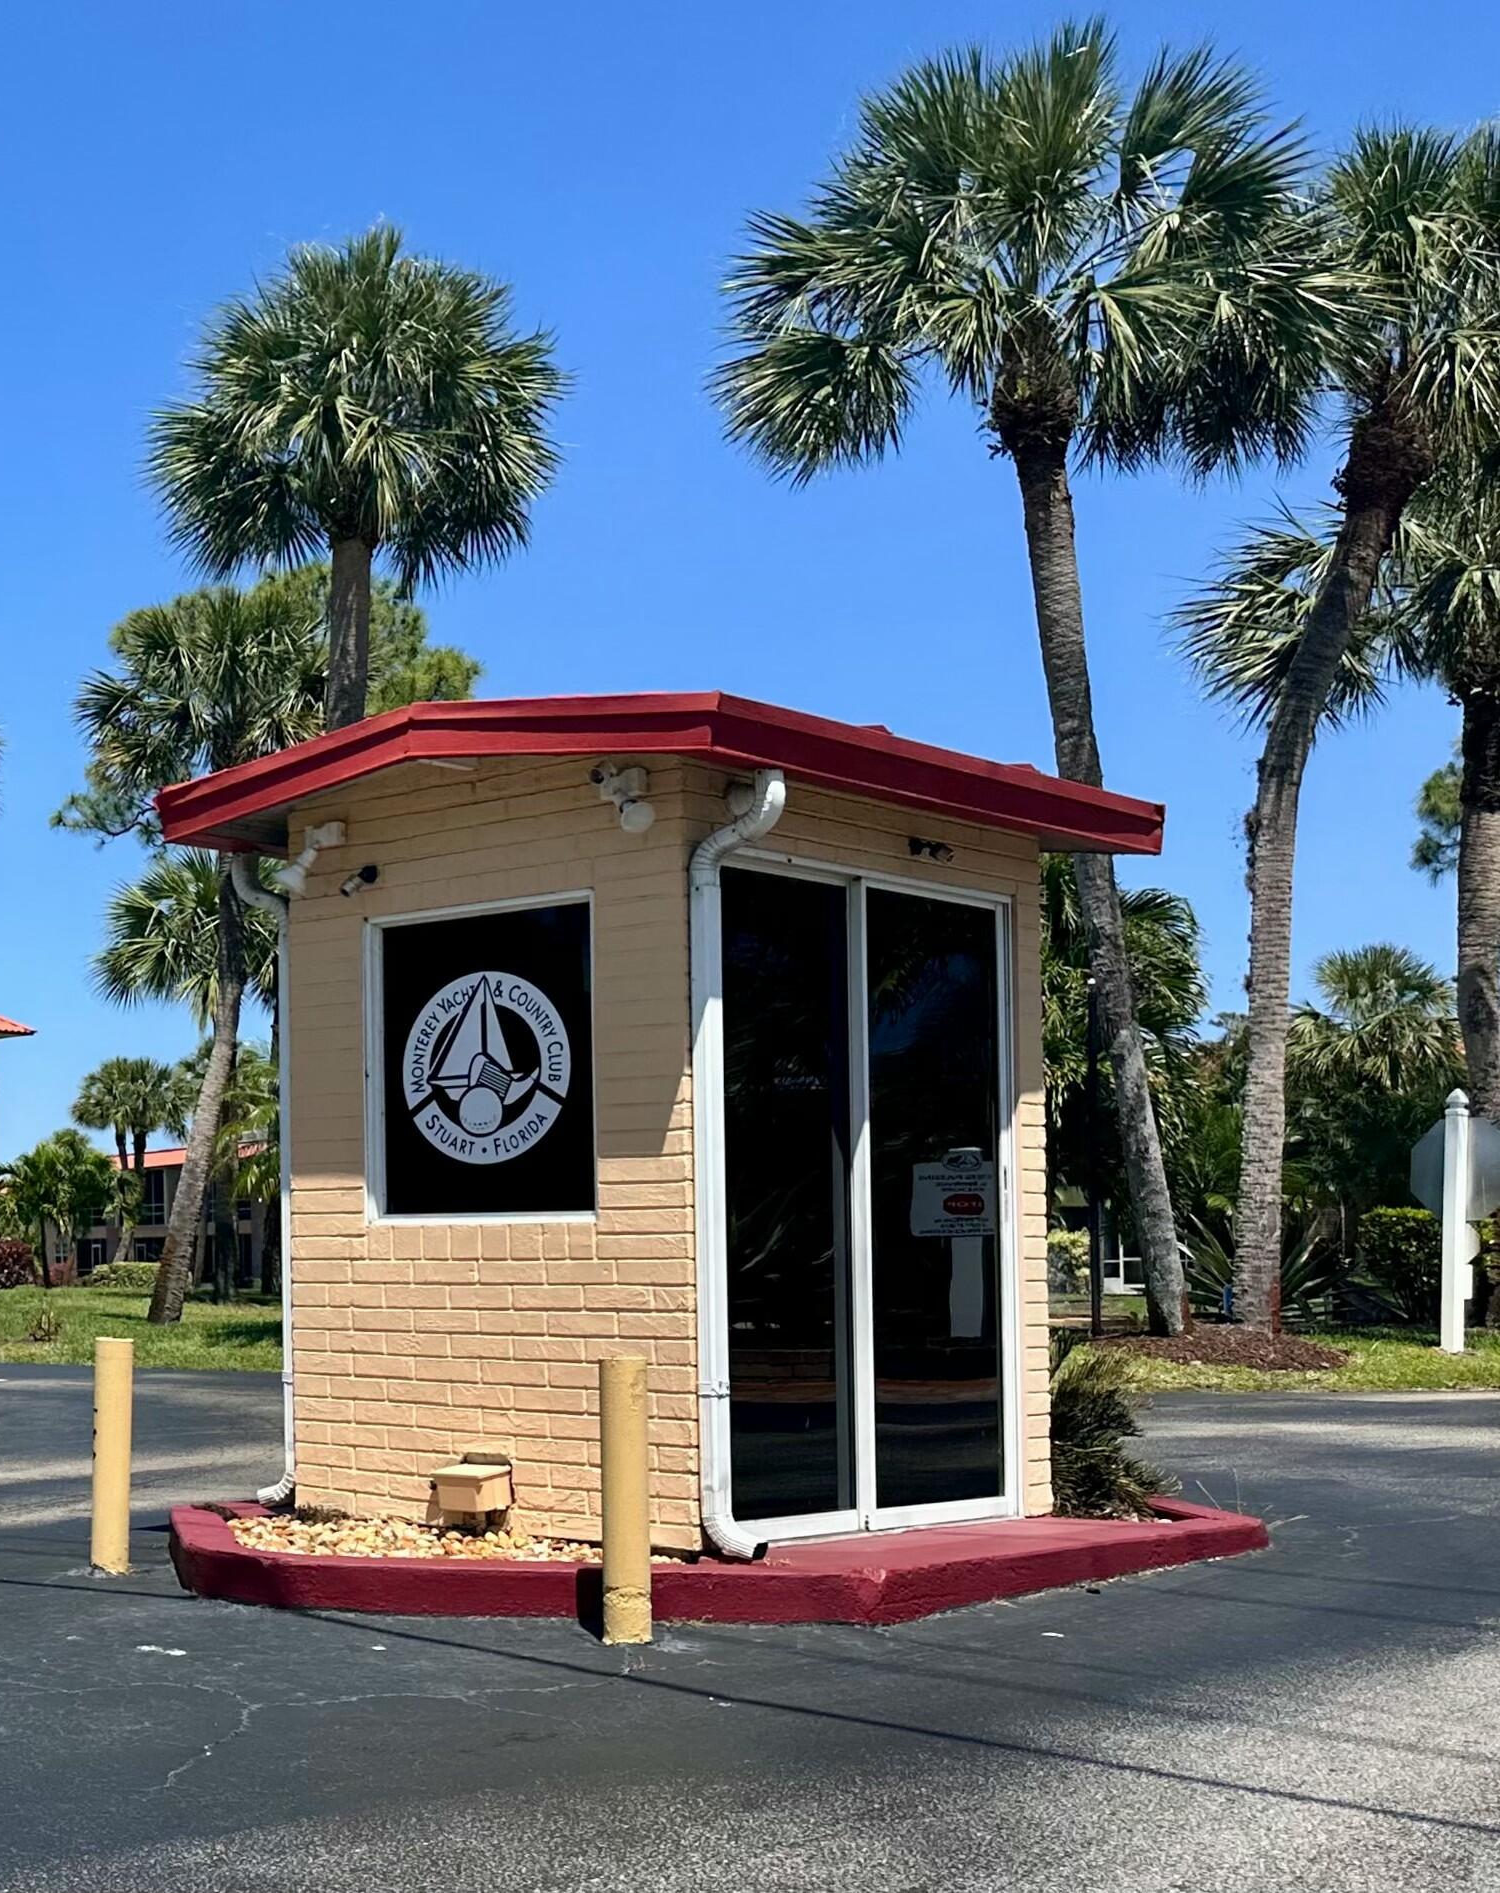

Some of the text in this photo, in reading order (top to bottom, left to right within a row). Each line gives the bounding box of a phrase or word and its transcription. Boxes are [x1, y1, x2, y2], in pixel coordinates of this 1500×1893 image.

[410, 980, 564, 1094] MONTEREY YACHT & COUNTRY CLUB
[425, 1112, 548, 1156] STUART FLORIDA
